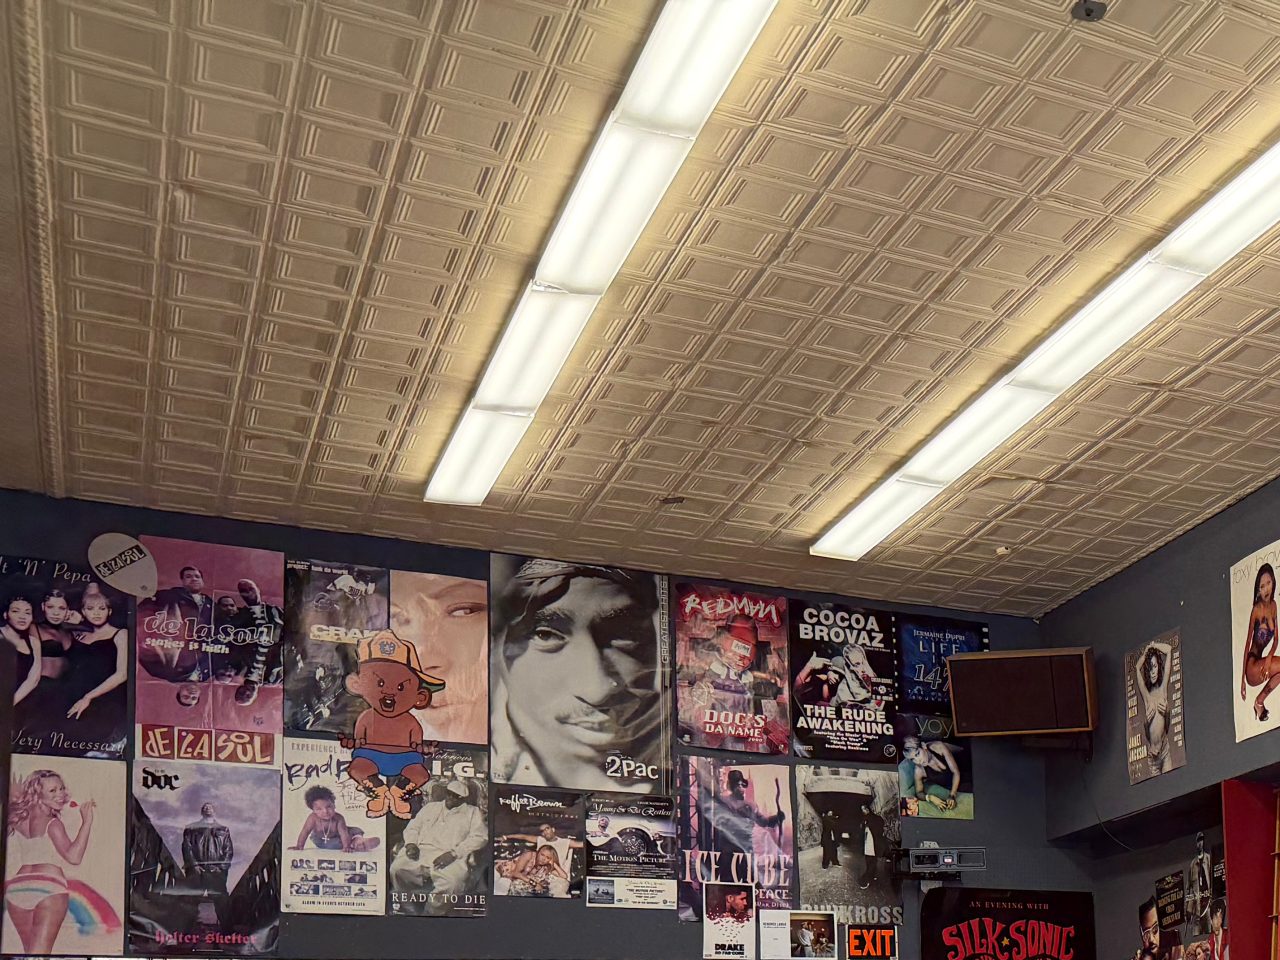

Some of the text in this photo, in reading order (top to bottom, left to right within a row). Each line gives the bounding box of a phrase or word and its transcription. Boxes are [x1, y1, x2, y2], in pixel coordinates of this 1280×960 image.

[53, 562, 91, 584] Pepa
[682, 592, 778, 625] REDMAN
[803, 608, 880, 631] COCOA
[144, 612, 274, 647] de la soul
[799, 625, 884, 648] BROVAZ
[202, 643, 230, 655] high
[920, 640, 960, 655] LIFE
[703, 709, 765, 728] DOC'S
[804, 704, 887, 723] THE RUDE
[705, 725, 762, 738] DA NAME
[797, 717, 894, 735] AWAKENING
[11, 730, 126, 754] Very Necessary
[605, 757, 659, 780] 2Pac
[593, 854, 608, 863] THE
[610, 855, 637, 863] MOTION
[683, 849, 791, 887] ICE CUBE
[392, 893, 486, 905] READY TO DIE
[755, 889, 788, 899] PEACE
[985, 901, 1024, 909] EVENING
[849, 929, 893, 956] EXIT
